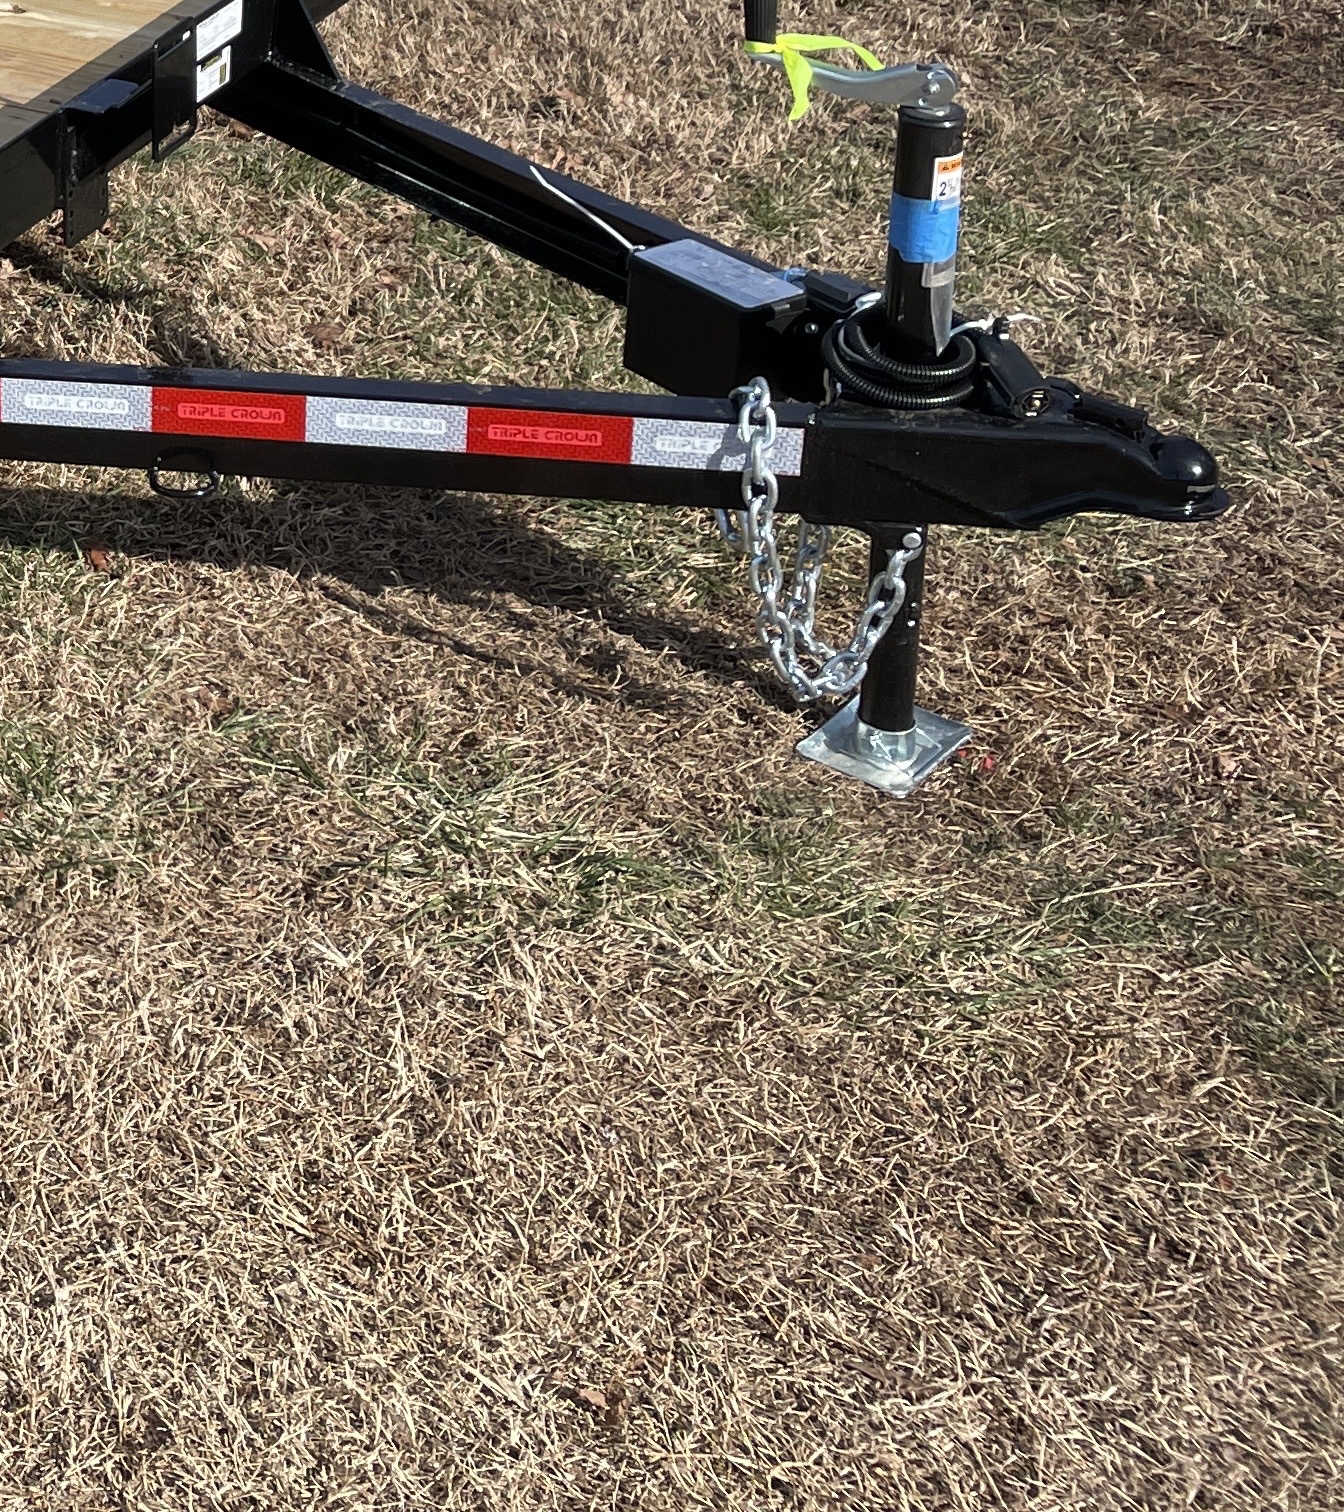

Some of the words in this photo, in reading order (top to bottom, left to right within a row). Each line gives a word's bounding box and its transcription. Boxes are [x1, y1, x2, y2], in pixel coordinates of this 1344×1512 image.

[76, 399, 126, 412] CROWN
[231, 408, 282, 422] CROWN
[390, 418, 443, 432] CROWN
[544, 430, 599, 444] CROWN
